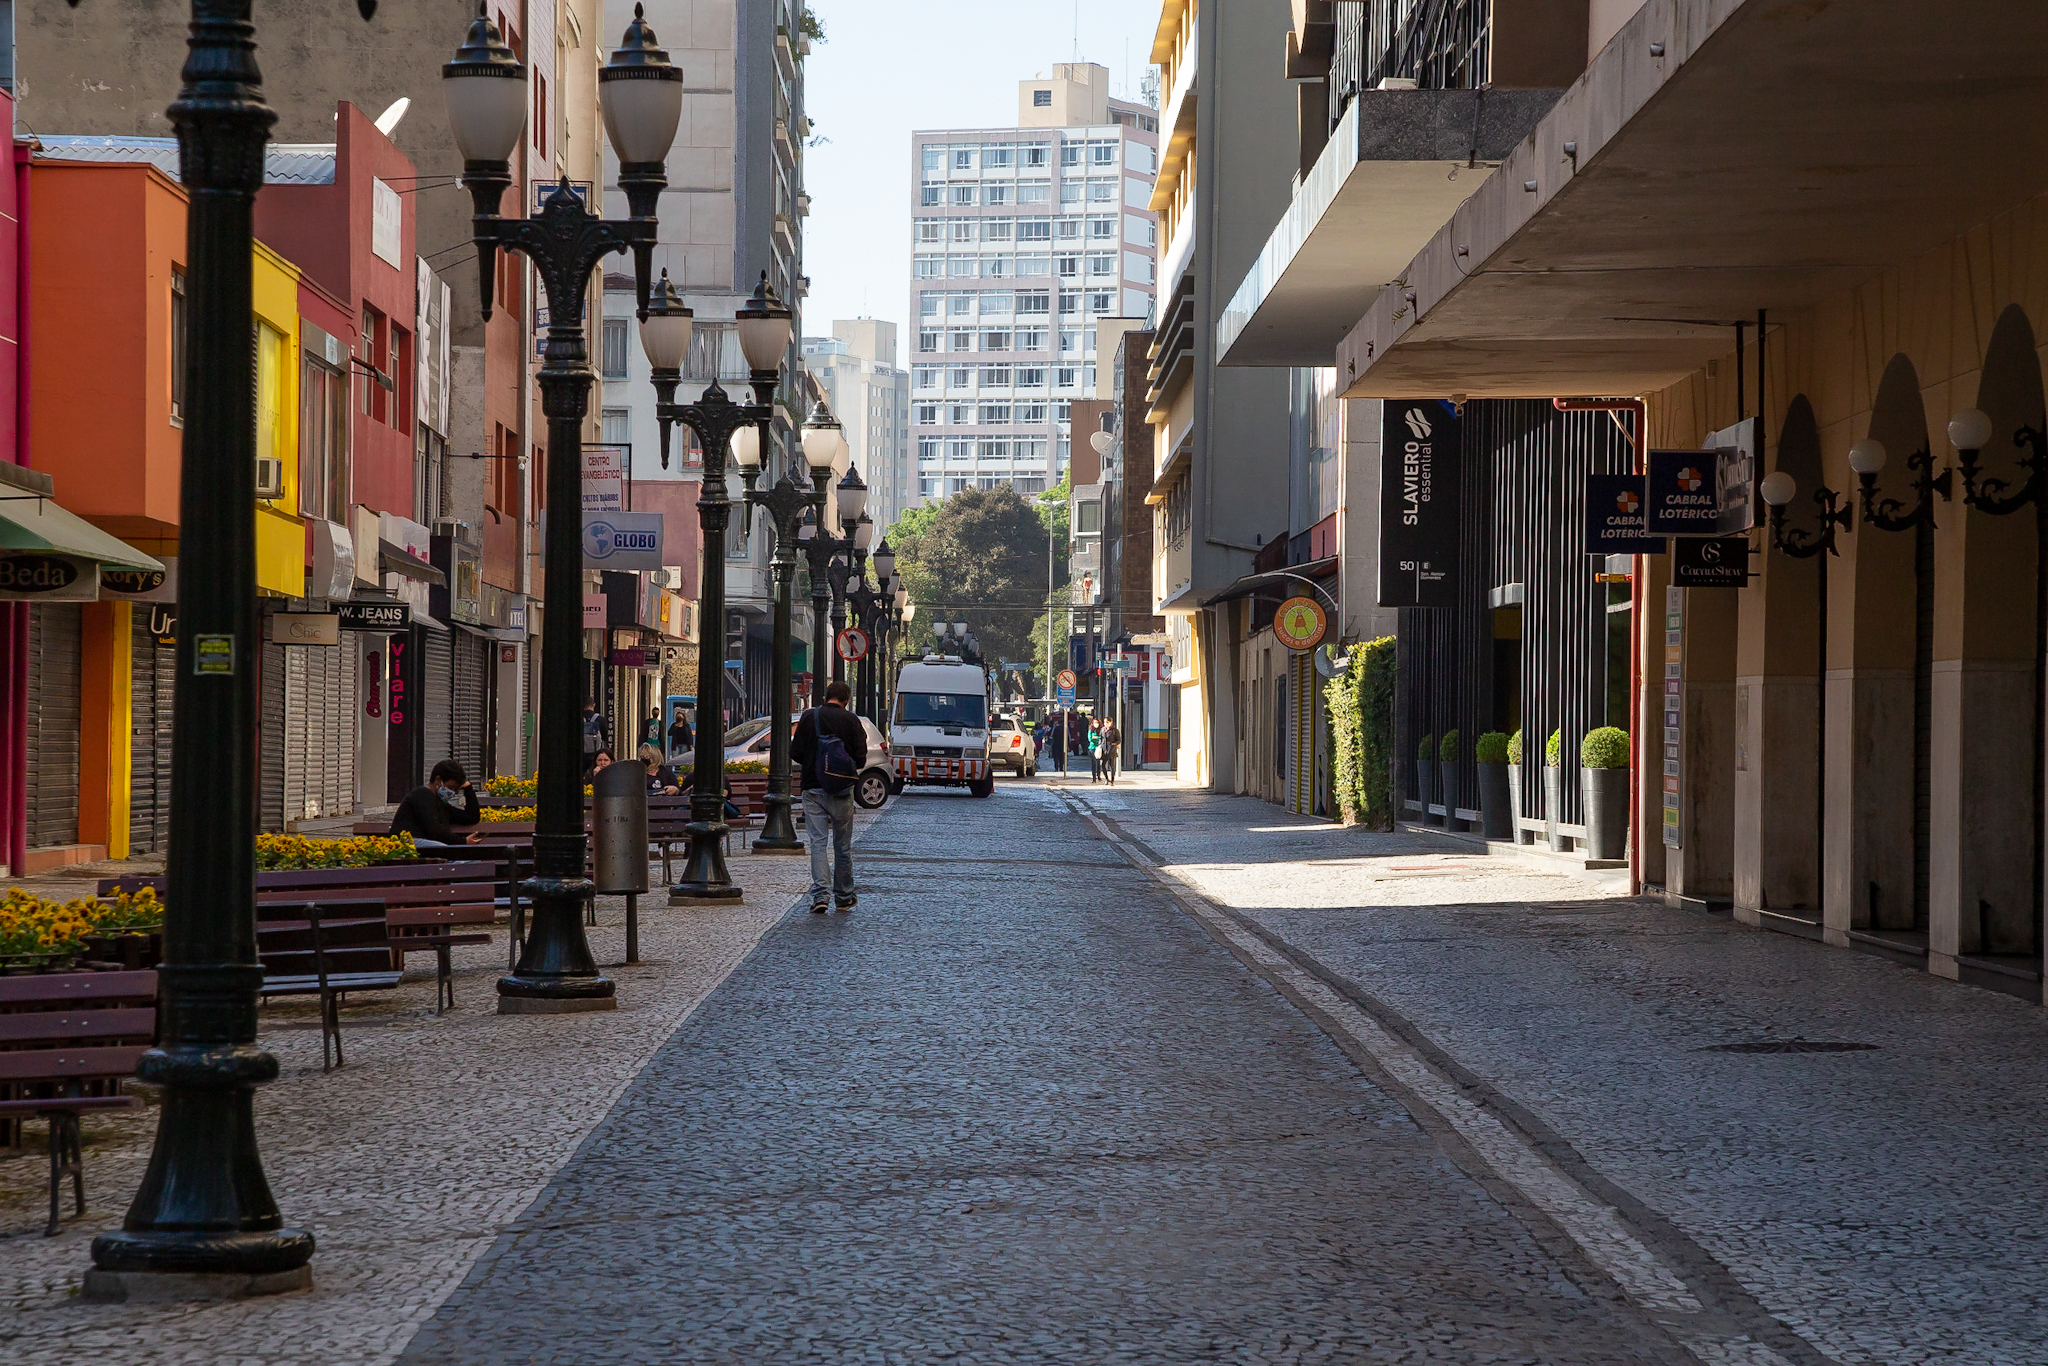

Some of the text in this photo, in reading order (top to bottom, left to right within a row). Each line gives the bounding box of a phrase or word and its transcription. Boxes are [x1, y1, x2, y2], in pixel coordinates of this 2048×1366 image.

[588, 456, 610, 467] CENTRO
[1420, 442, 1432, 502] essential
[1403, 441, 1419, 526] SLAVIERO
[1665, 494, 1712, 505] CABRAL
[1659, 507, 1718, 519] LOTÉRICO
[1600, 526, 1650, 539] LOTÉRIC
[614, 533, 656, 549] GLOBO
[1400, 560, 1415, 571] 50
[0, 561, 65, 586] Beda
[357, 607, 403, 620] JEANS
[289, 622, 322, 639] Chic
[614, 651, 643, 660] AVON
